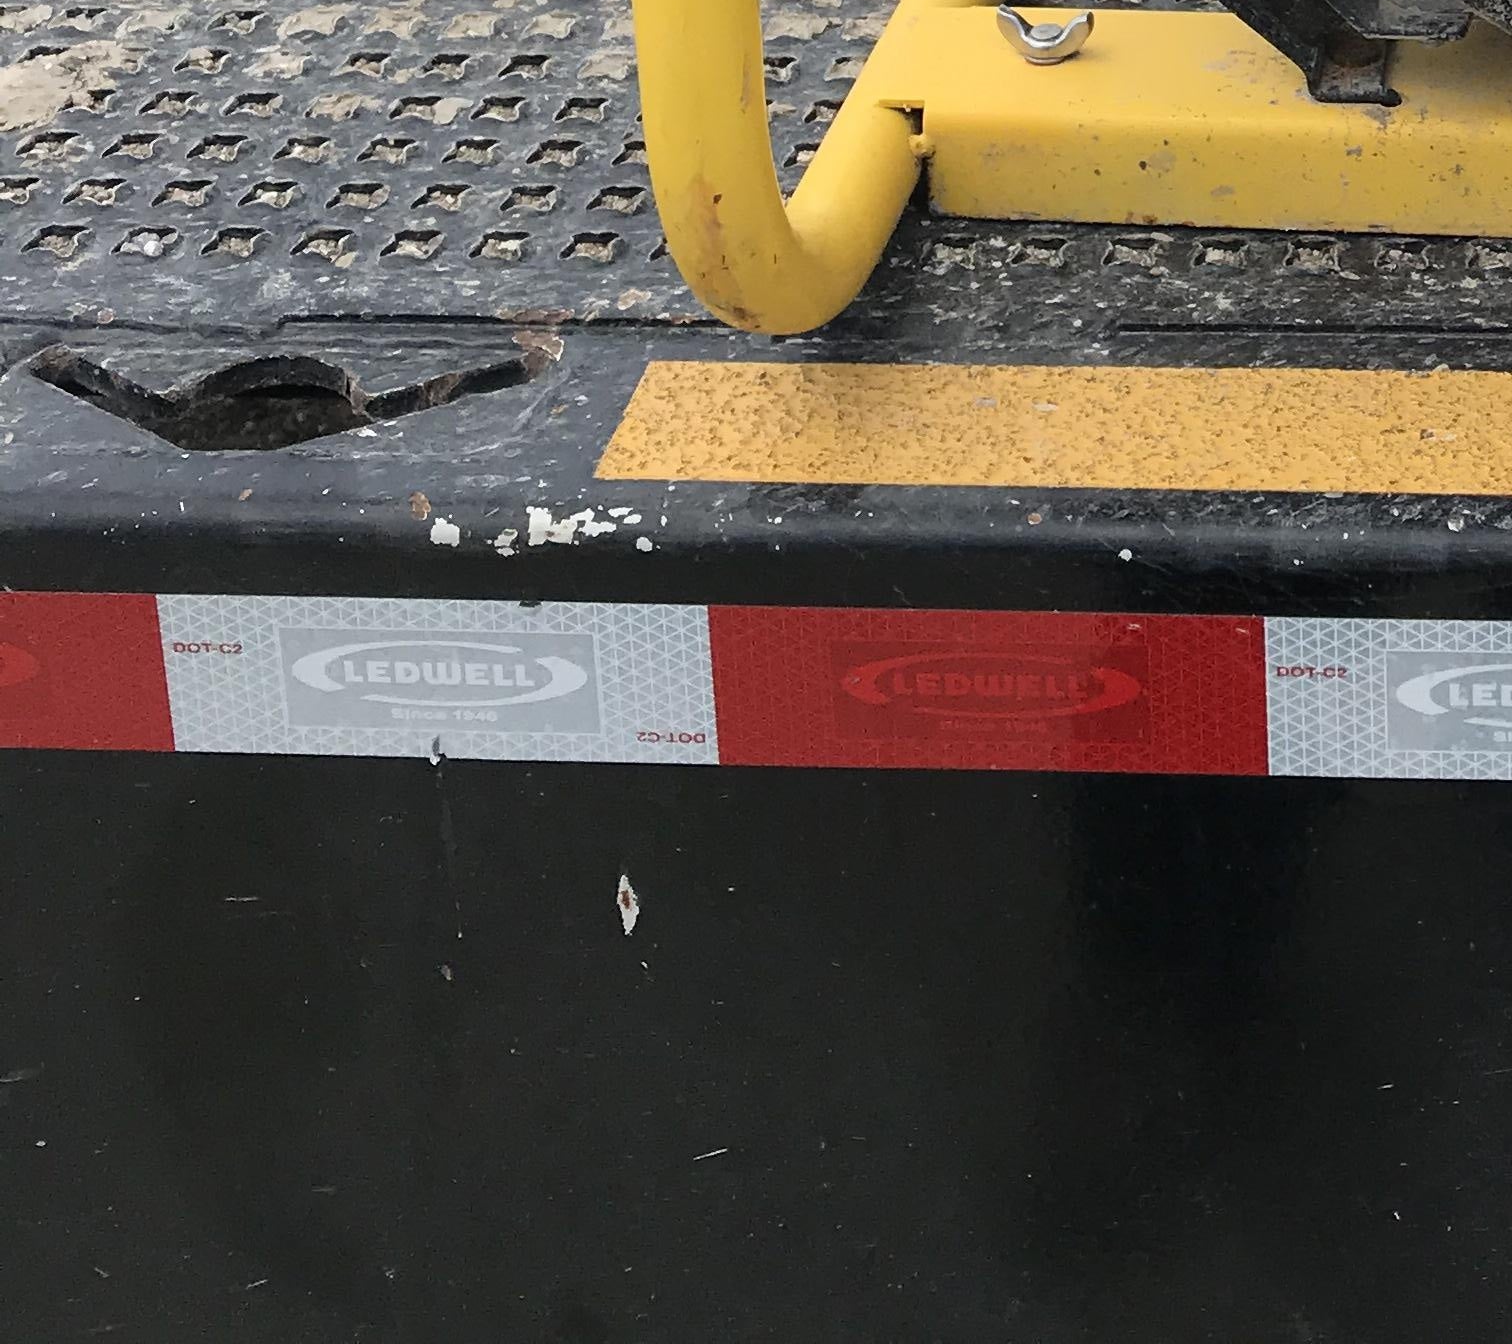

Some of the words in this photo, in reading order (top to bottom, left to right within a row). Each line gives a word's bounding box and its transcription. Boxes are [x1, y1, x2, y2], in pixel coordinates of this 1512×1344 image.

[173, 642, 243, 654] DOT-C2
[344, 660, 535, 689] LEDWELL
[1275, 666, 1347, 678] DOT-C2
[892, 672, 1087, 700] LEDWELL
[392, 708, 447, 721] Since
[636, 732, 706, 744] DOT-C2
